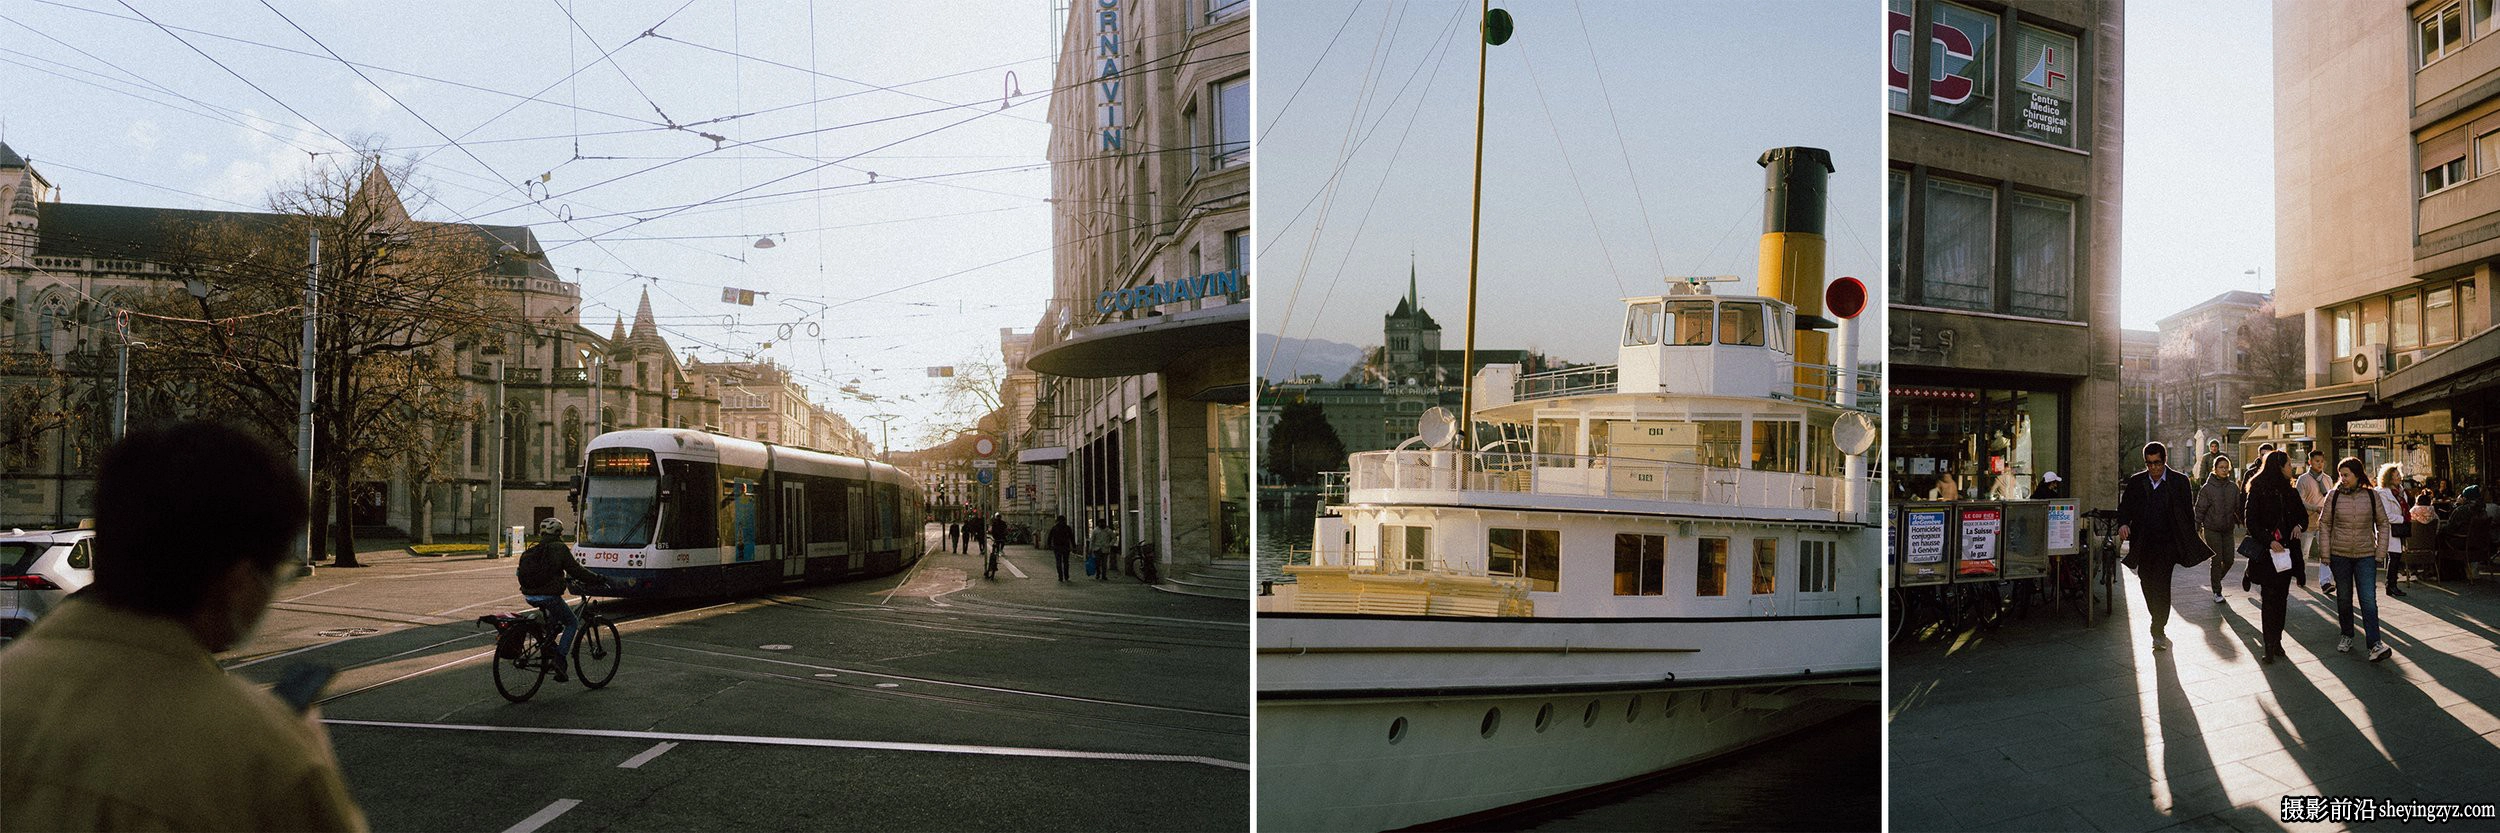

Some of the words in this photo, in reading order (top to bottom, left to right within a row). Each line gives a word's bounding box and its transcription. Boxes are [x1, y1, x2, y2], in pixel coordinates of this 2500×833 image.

[2031, 92, 2059, 107] Centre
[2030, 101, 2060, 116] Medico
[2023, 108, 2067, 127] Chirurgical
[2027, 119, 2063, 135] Cornavin
[1095, 268, 1238, 314] CORNAVIN
[1383, 388, 1405, 396] PATEK
[2280, 407, 2319, 420] Restaurant
[1911, 533, 1942, 541] conjugaux
[1917, 546, 1940, 554] Genève
